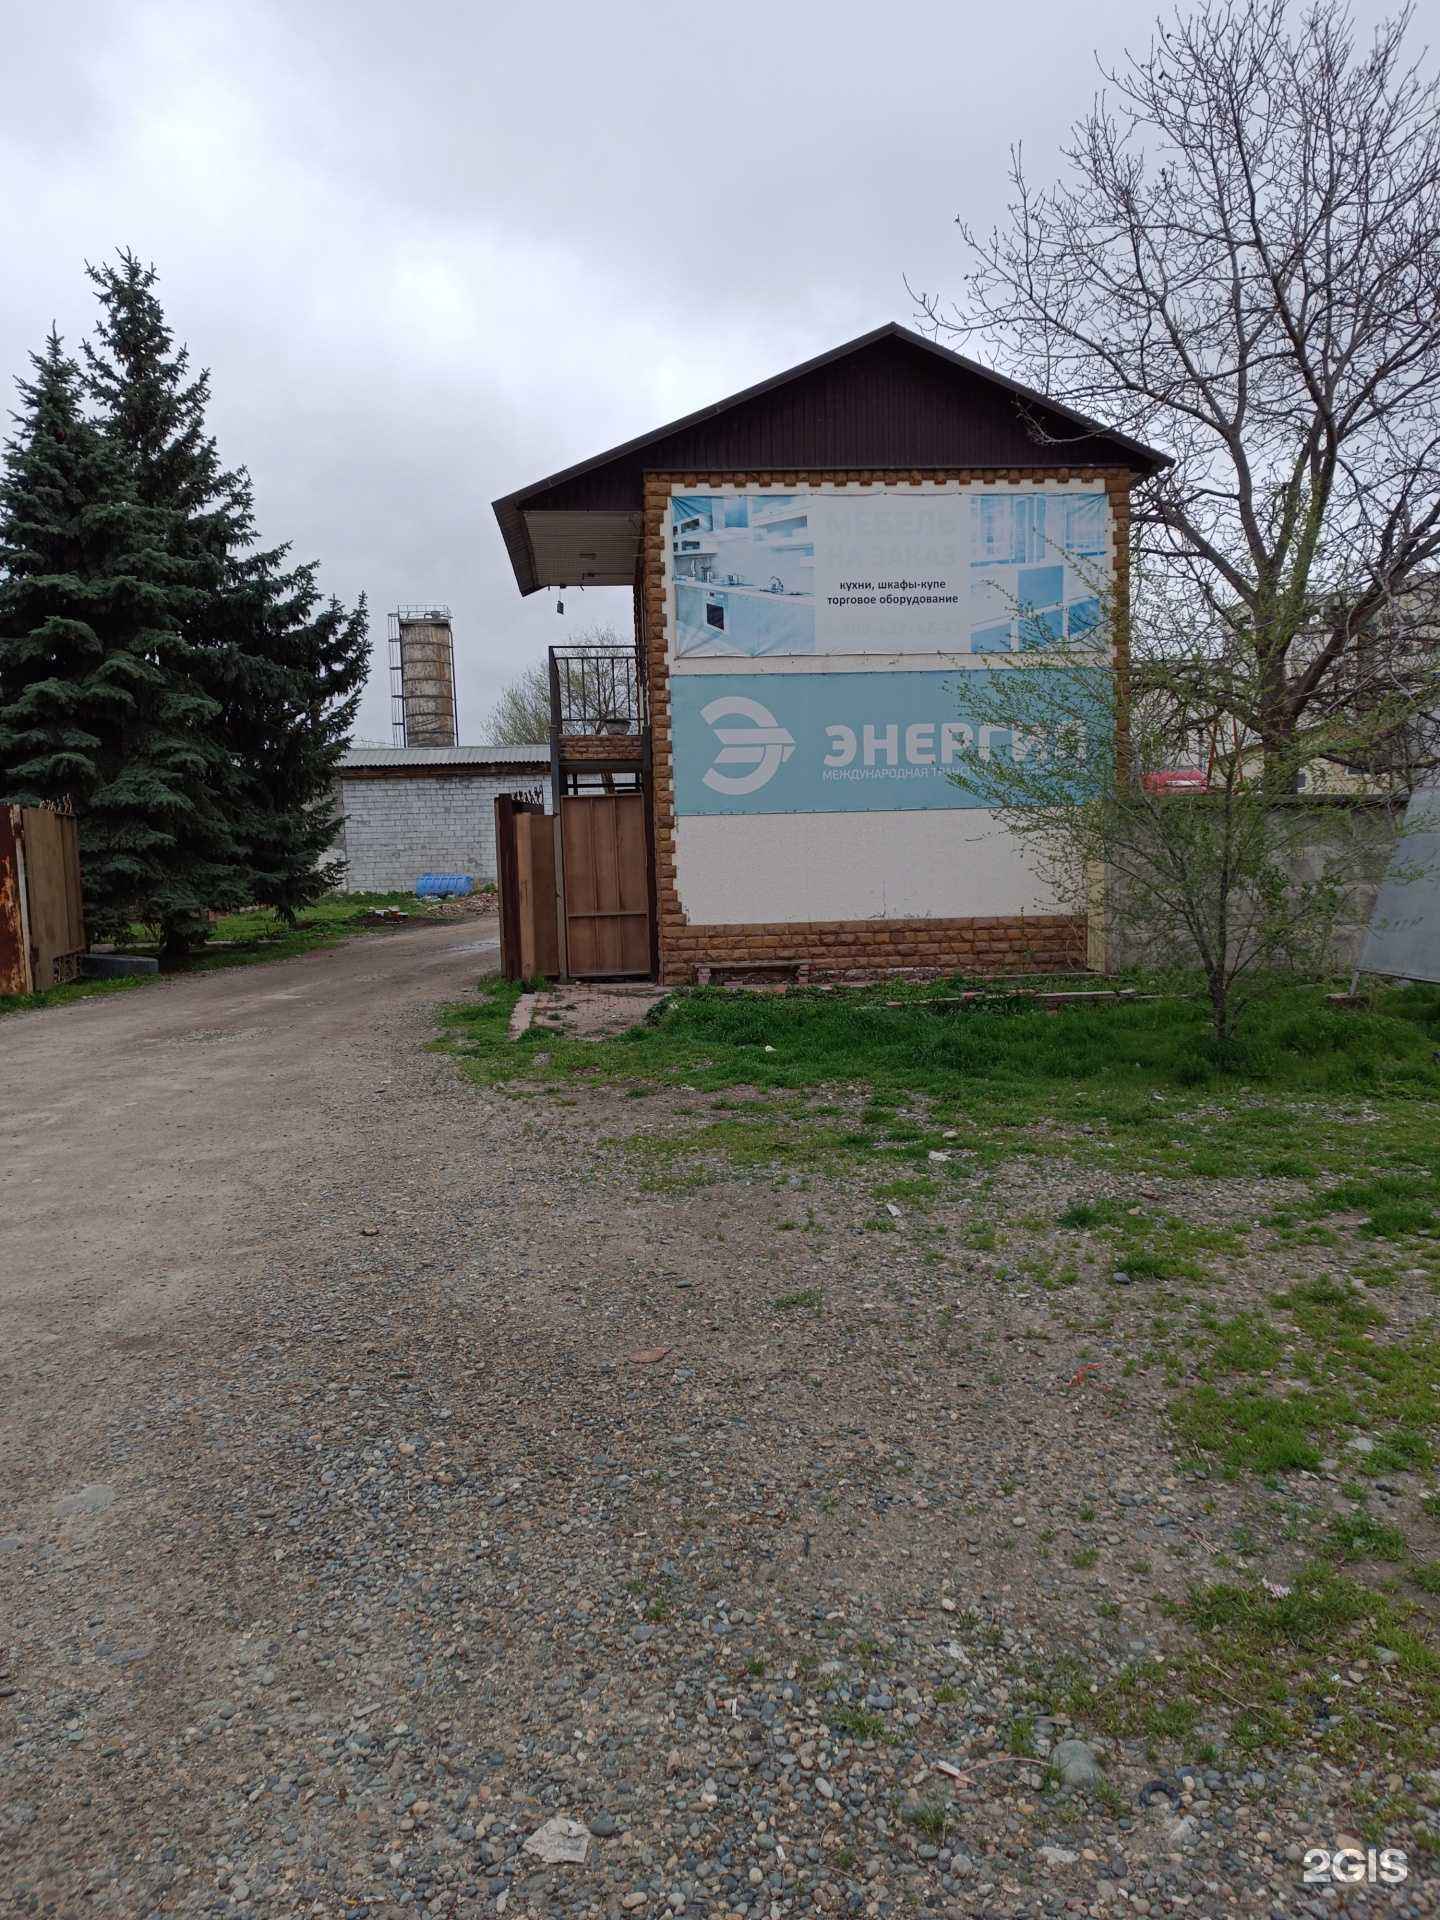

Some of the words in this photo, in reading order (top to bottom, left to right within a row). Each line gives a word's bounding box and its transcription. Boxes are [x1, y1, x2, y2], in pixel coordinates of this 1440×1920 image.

[826, 511, 957, 536] МЕБЕЛЬ
[826, 544, 864, 568] НА
[871, 544, 957, 568] ЗАКАЗ
[839, 579, 875, 591] кухни,
[877, 578, 946, 591] шкафы-купе
[827, 595, 876, 606] торговое
[879, 593, 958, 606] оборудование
[822, 768, 929, 781] МЕЖДУНАРОДНАЯ
